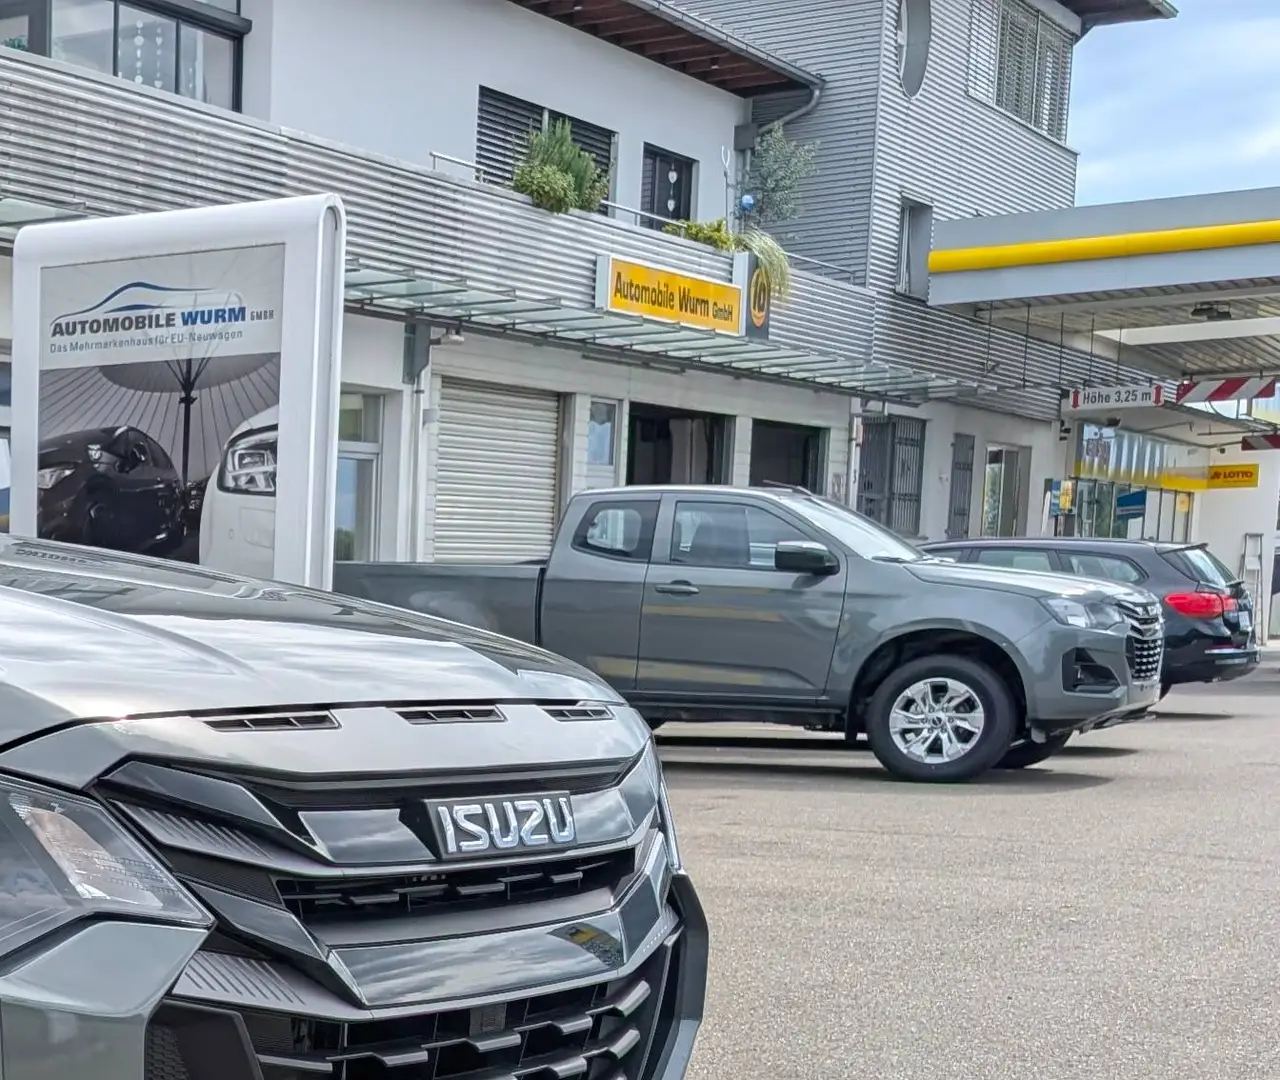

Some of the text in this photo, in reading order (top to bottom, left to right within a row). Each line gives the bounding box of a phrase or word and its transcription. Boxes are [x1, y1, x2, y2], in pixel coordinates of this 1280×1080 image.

[614, 271, 733, 322] Automobile Wurm GmbH
[51, 306, 274, 338] AUTOMOBILE WURM GMBH
[49, 330, 243, 353] Das Mehrmarkenhaus für EU-Neuwagen
[1082, 388, 1152, 404] Höhe 3,25 m
[1223, 470, 1253, 480] LOTTO
[437, 797, 575, 853] ISUZU
